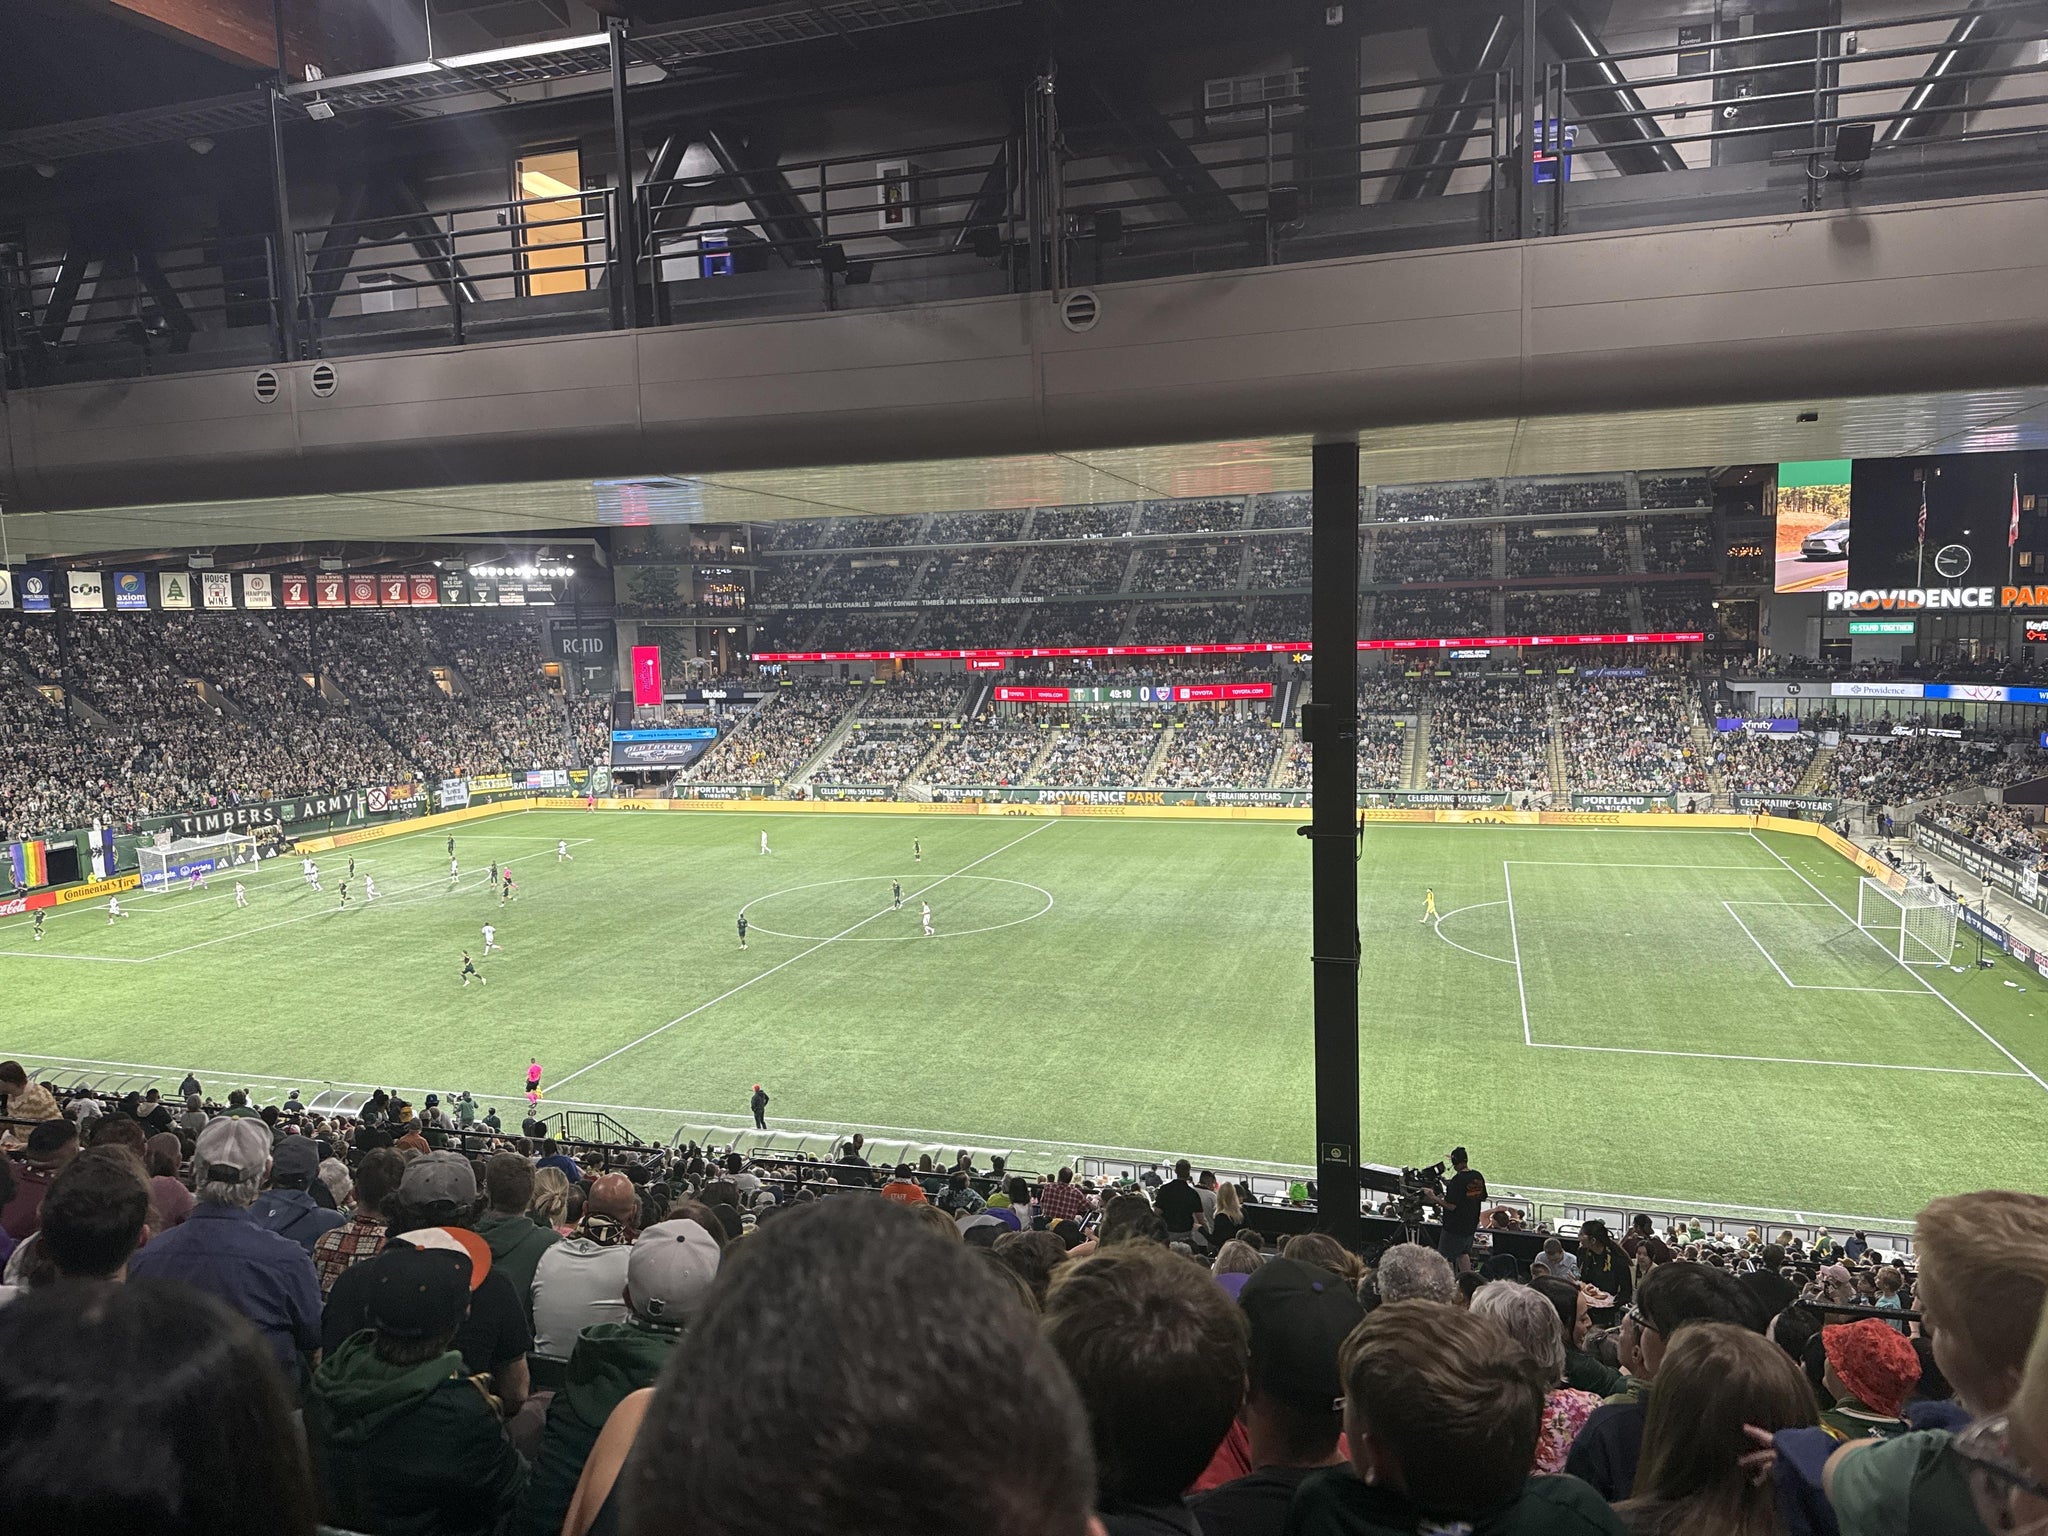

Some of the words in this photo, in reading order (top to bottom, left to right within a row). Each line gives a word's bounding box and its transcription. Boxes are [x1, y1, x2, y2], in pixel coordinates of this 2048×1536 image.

[1681, 37, 1701, 45] Control
[205, 574, 229, 583] HOUSE
[117, 593, 146, 601] axiom
[208, 597, 228, 605] WINE
[1827, 587, 1994, 611] PROVIDENCE
[1858, 624, 1879, 632] STAND
[1880, 624, 1914, 632] TOGETHER
[702, 689, 727, 698] Modelo
[1092, 687, 1099, 701] 1
[1109, 689, 1132, 699] 49:18
[1140, 687, 1150, 702] 0
[1863, 685, 1906, 695] Providence
[1742, 720, 1773, 730] xfinity
[1891, 726, 1915, 736] Ford
[648, 743, 692, 751] TRAPPER
[1039, 790, 1126, 802] PROVIDENCE
[1127, 792, 1164, 804] PARK
[1206, 792, 1249, 800] CLEBRATING
[1250, 792, 1259, 800] 50
[1260, 792, 1281, 800] YEARS
[1468, 795, 1491, 803] YEARS
[1583, 796, 1645, 806] PORTLAND
[1740, 798, 1794, 808] CELERATIN
[1796, 800, 1807, 809] 50
[1807, 801, 1833, 811] YEARS
[181, 808, 274, 833] TIMBERS
[303, 794, 354, 818] ARMY
[64, 882, 110, 901] Continental
